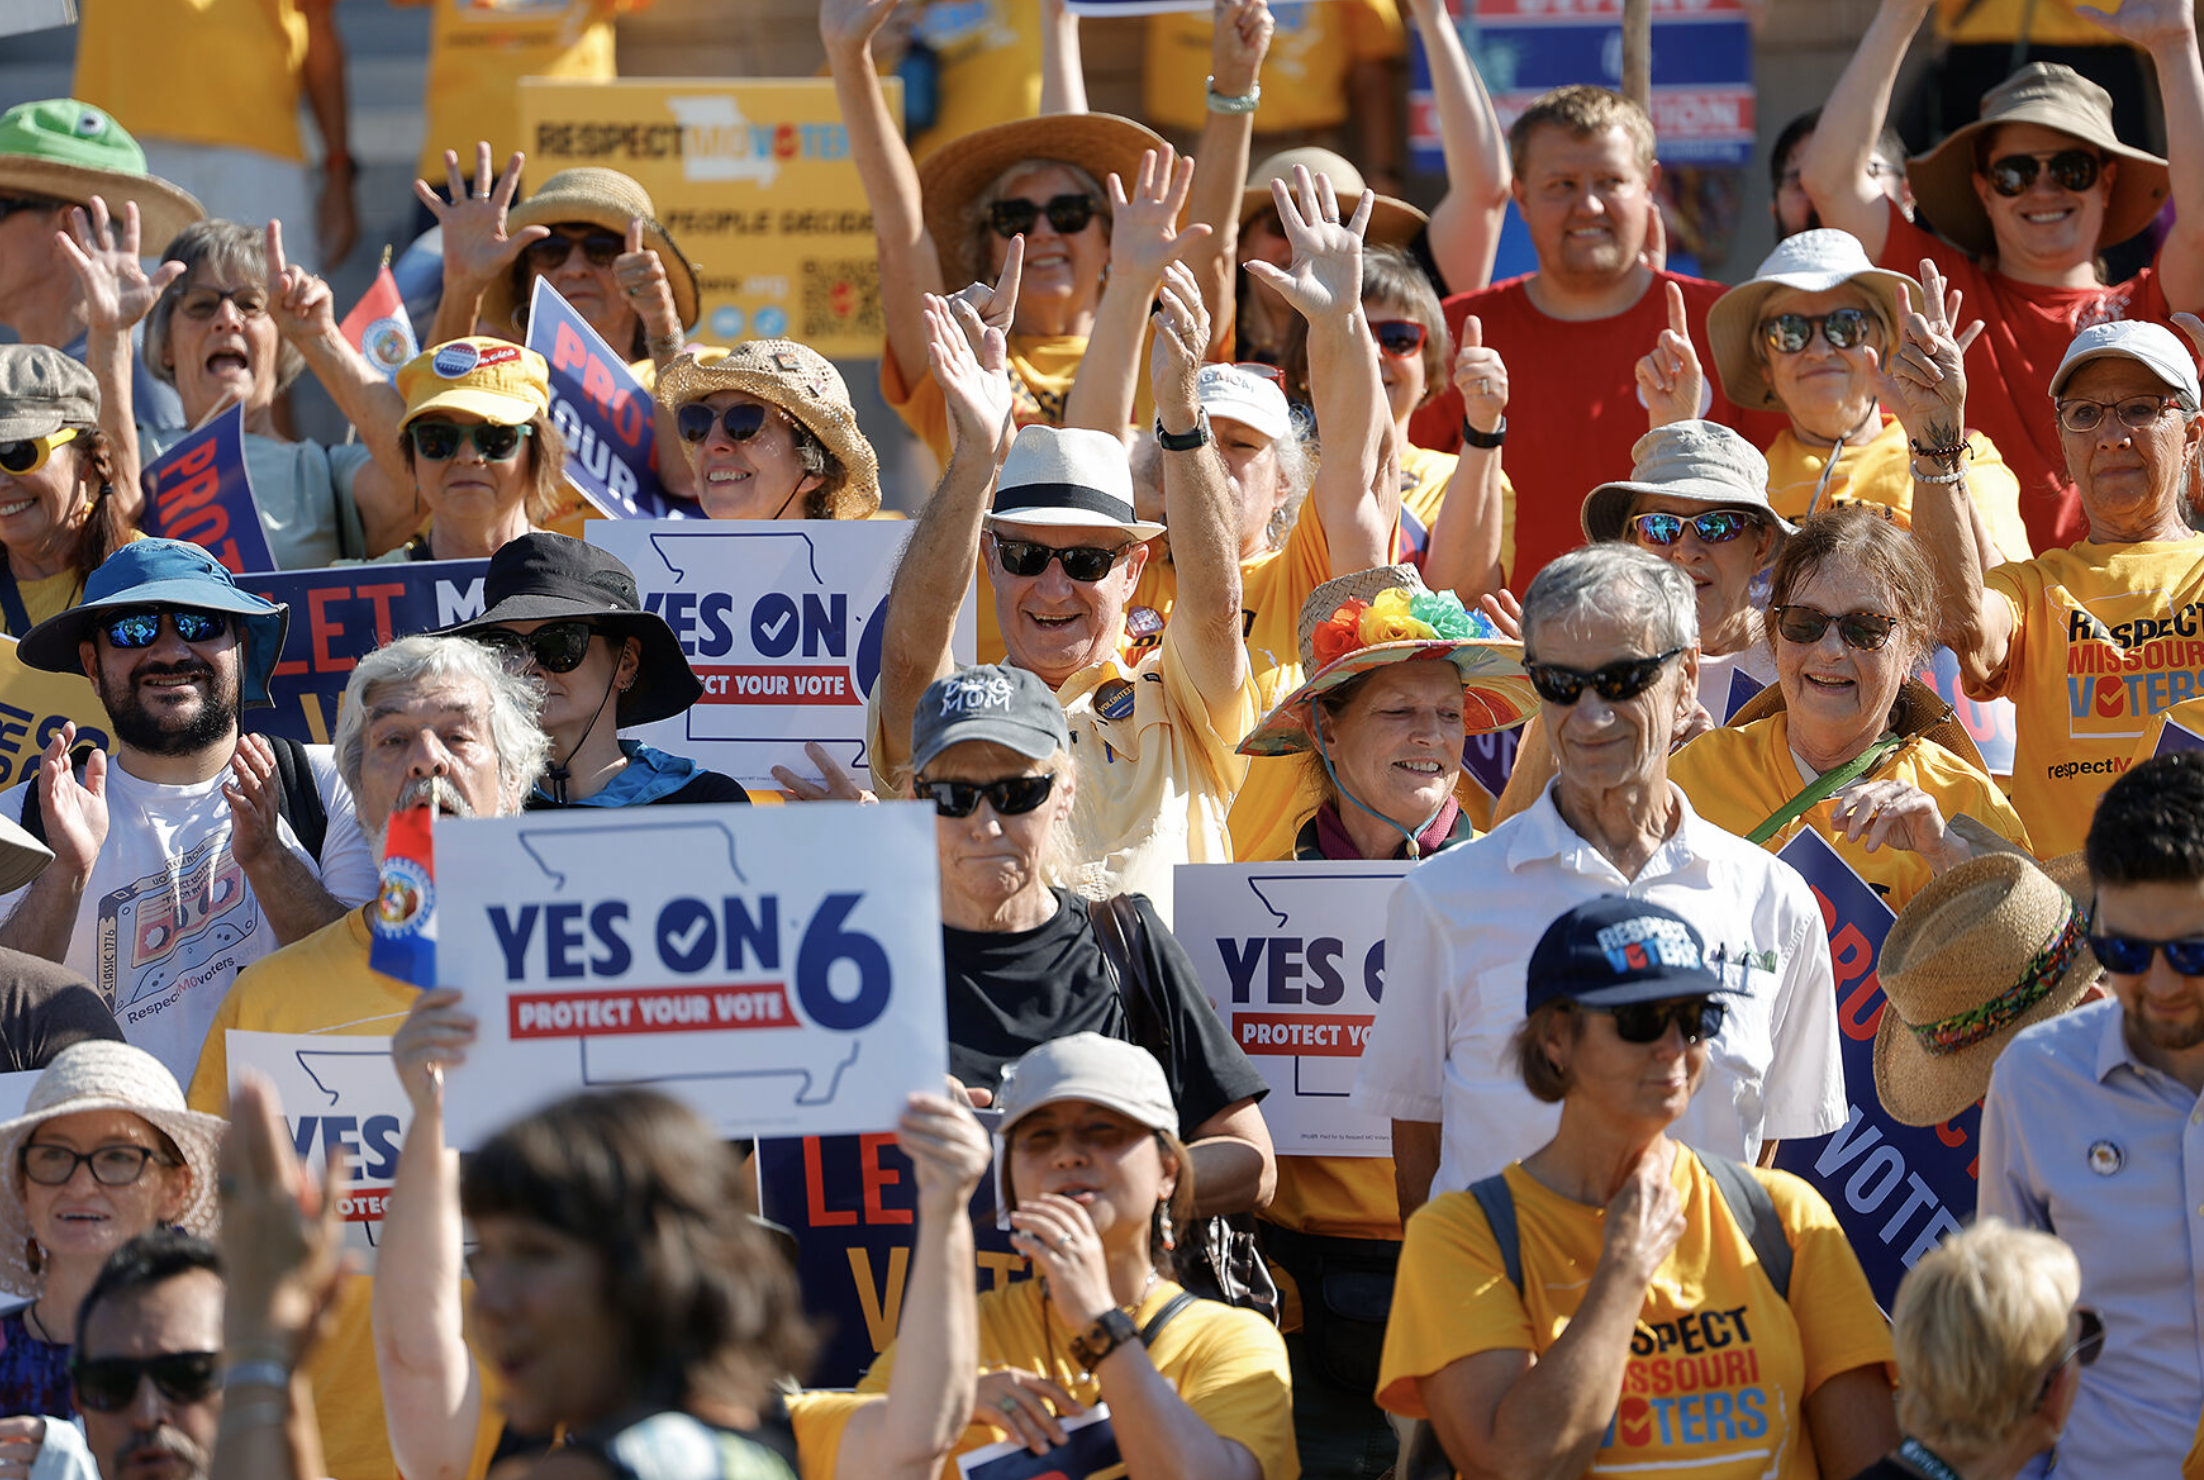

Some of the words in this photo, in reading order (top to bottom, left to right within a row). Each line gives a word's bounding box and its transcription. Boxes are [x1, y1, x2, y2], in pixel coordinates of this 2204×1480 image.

[550, 387, 638, 515] OUR
[750, 592, 847, 658] ON
[735, 676, 789, 696] YOUR
[794, 676, 845, 696] VOTE
[939, 690, 1012, 717] MOM
[1596, 916, 1692, 952] RESPECT
[102, 953, 115, 991] CLASSIC
[485, 900, 633, 981] YES
[656, 894, 781, 975] ON
[795, 892, 893, 1033] 6
[1216, 937, 1345, 1006] YES
[1605, 938, 1701, 975] VOTERS
[518, 996, 633, 1031] PROTECT
[638, 994, 708, 1025] YOUR
[714, 991, 783, 1022] VOTE
[1243, 1023, 1341, 1046] PROTECT
[1814, 1103, 1964, 1272] VOTE
